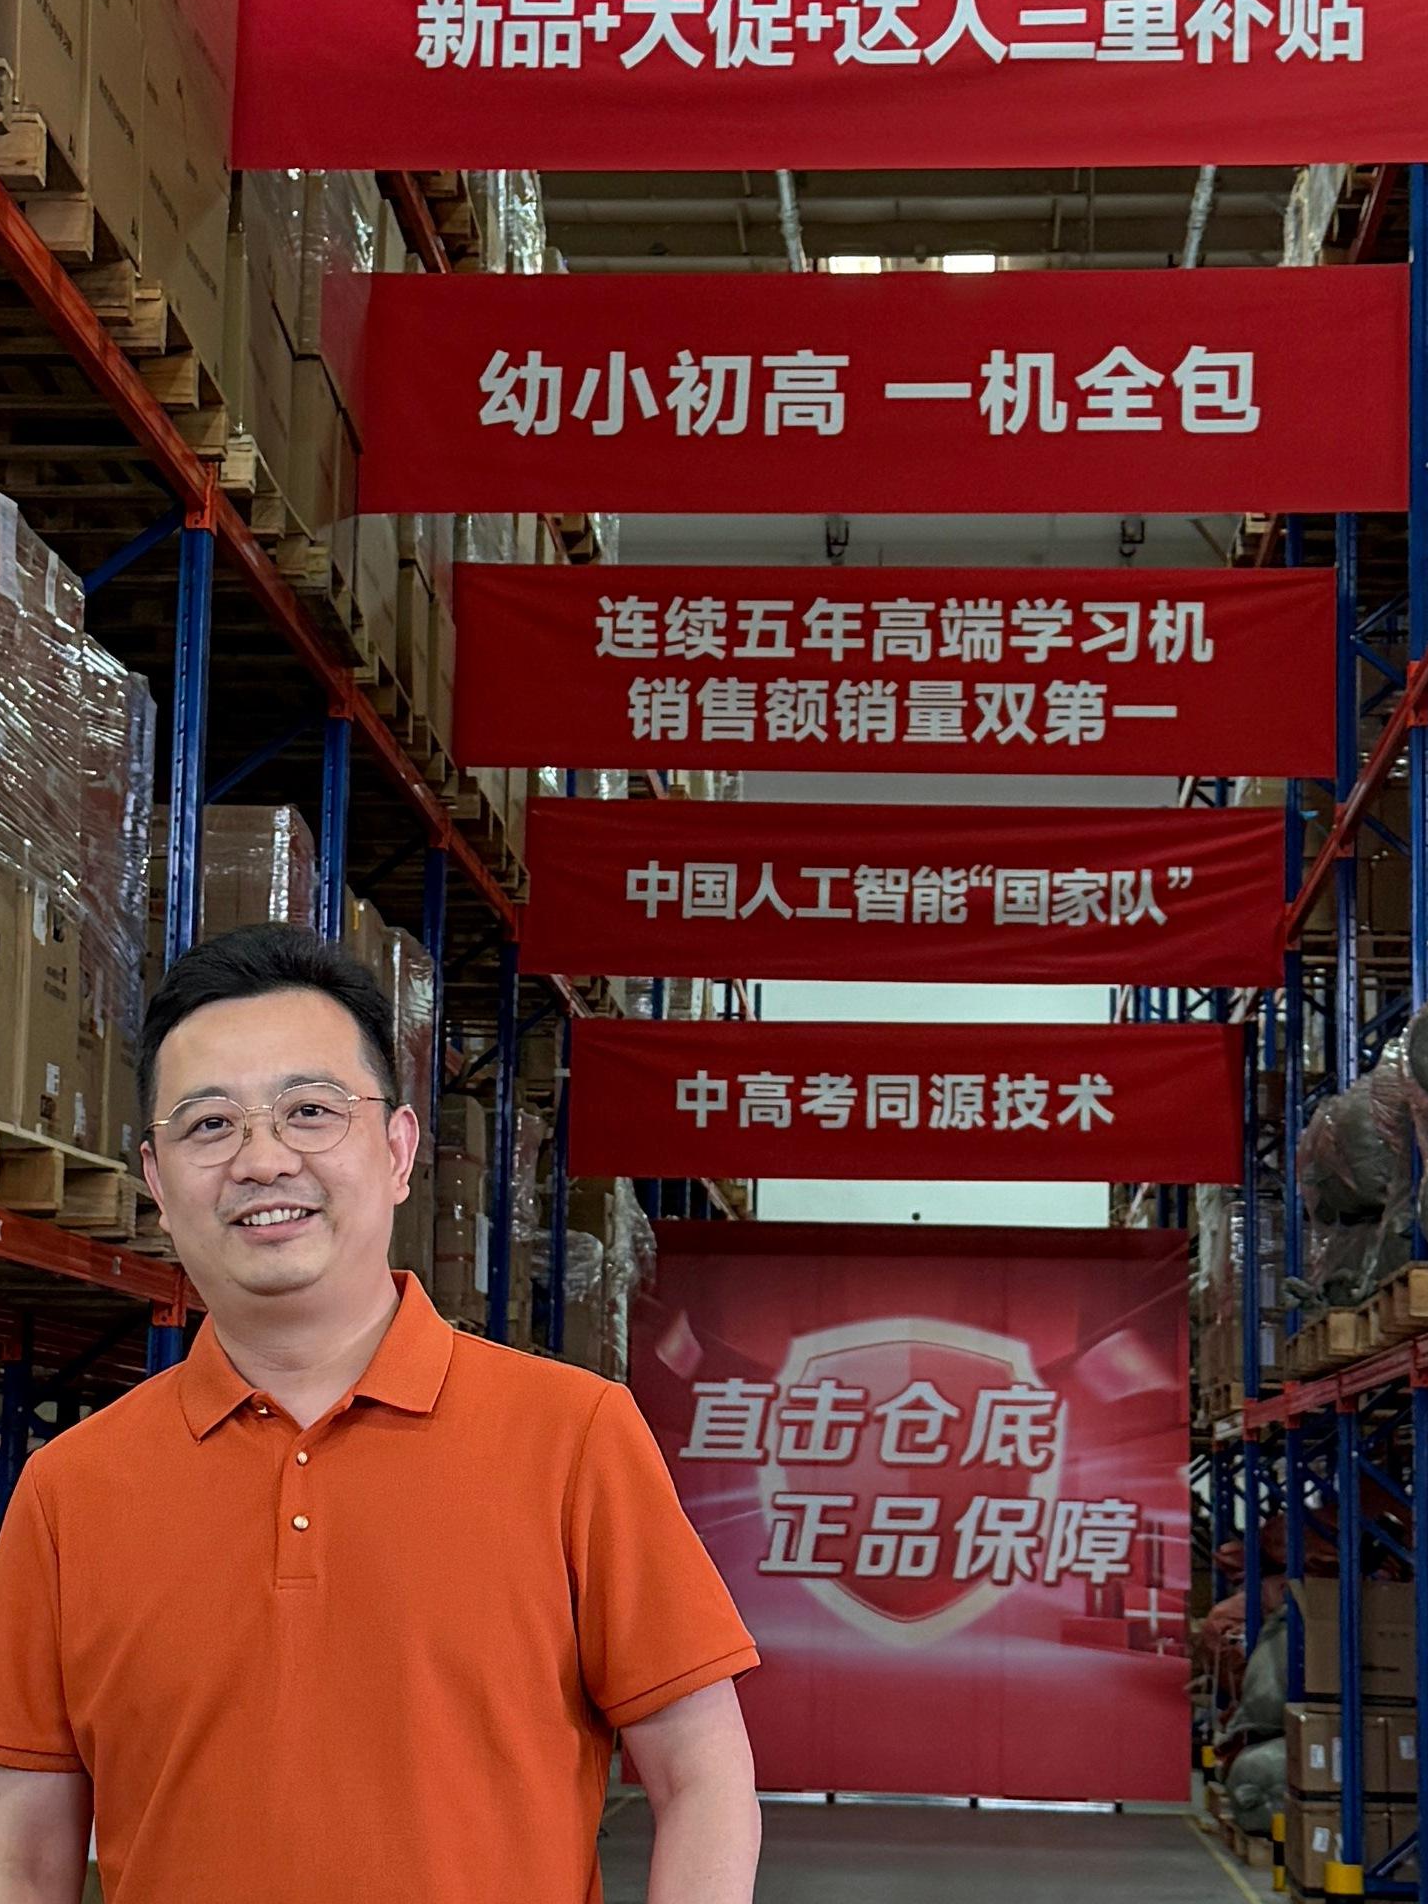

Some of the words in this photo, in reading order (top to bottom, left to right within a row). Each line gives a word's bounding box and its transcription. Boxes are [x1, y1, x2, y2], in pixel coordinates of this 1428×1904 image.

[480, 350, 848, 435] 幼小初高
[885, 346, 1260, 434] 一机全包
[597, 597, 1213, 663] 连续五年高端学习机
[629, 678, 1176, 744] 销售额销量双第一
[626, 861, 1192, 927] 中国人工智能“国家队”
[675, 1070, 1114, 1131] 中高考同源技术
[679, 1377, 1058, 1468] 直击仓底
[759, 1493, 1139, 1584] 正品保障
